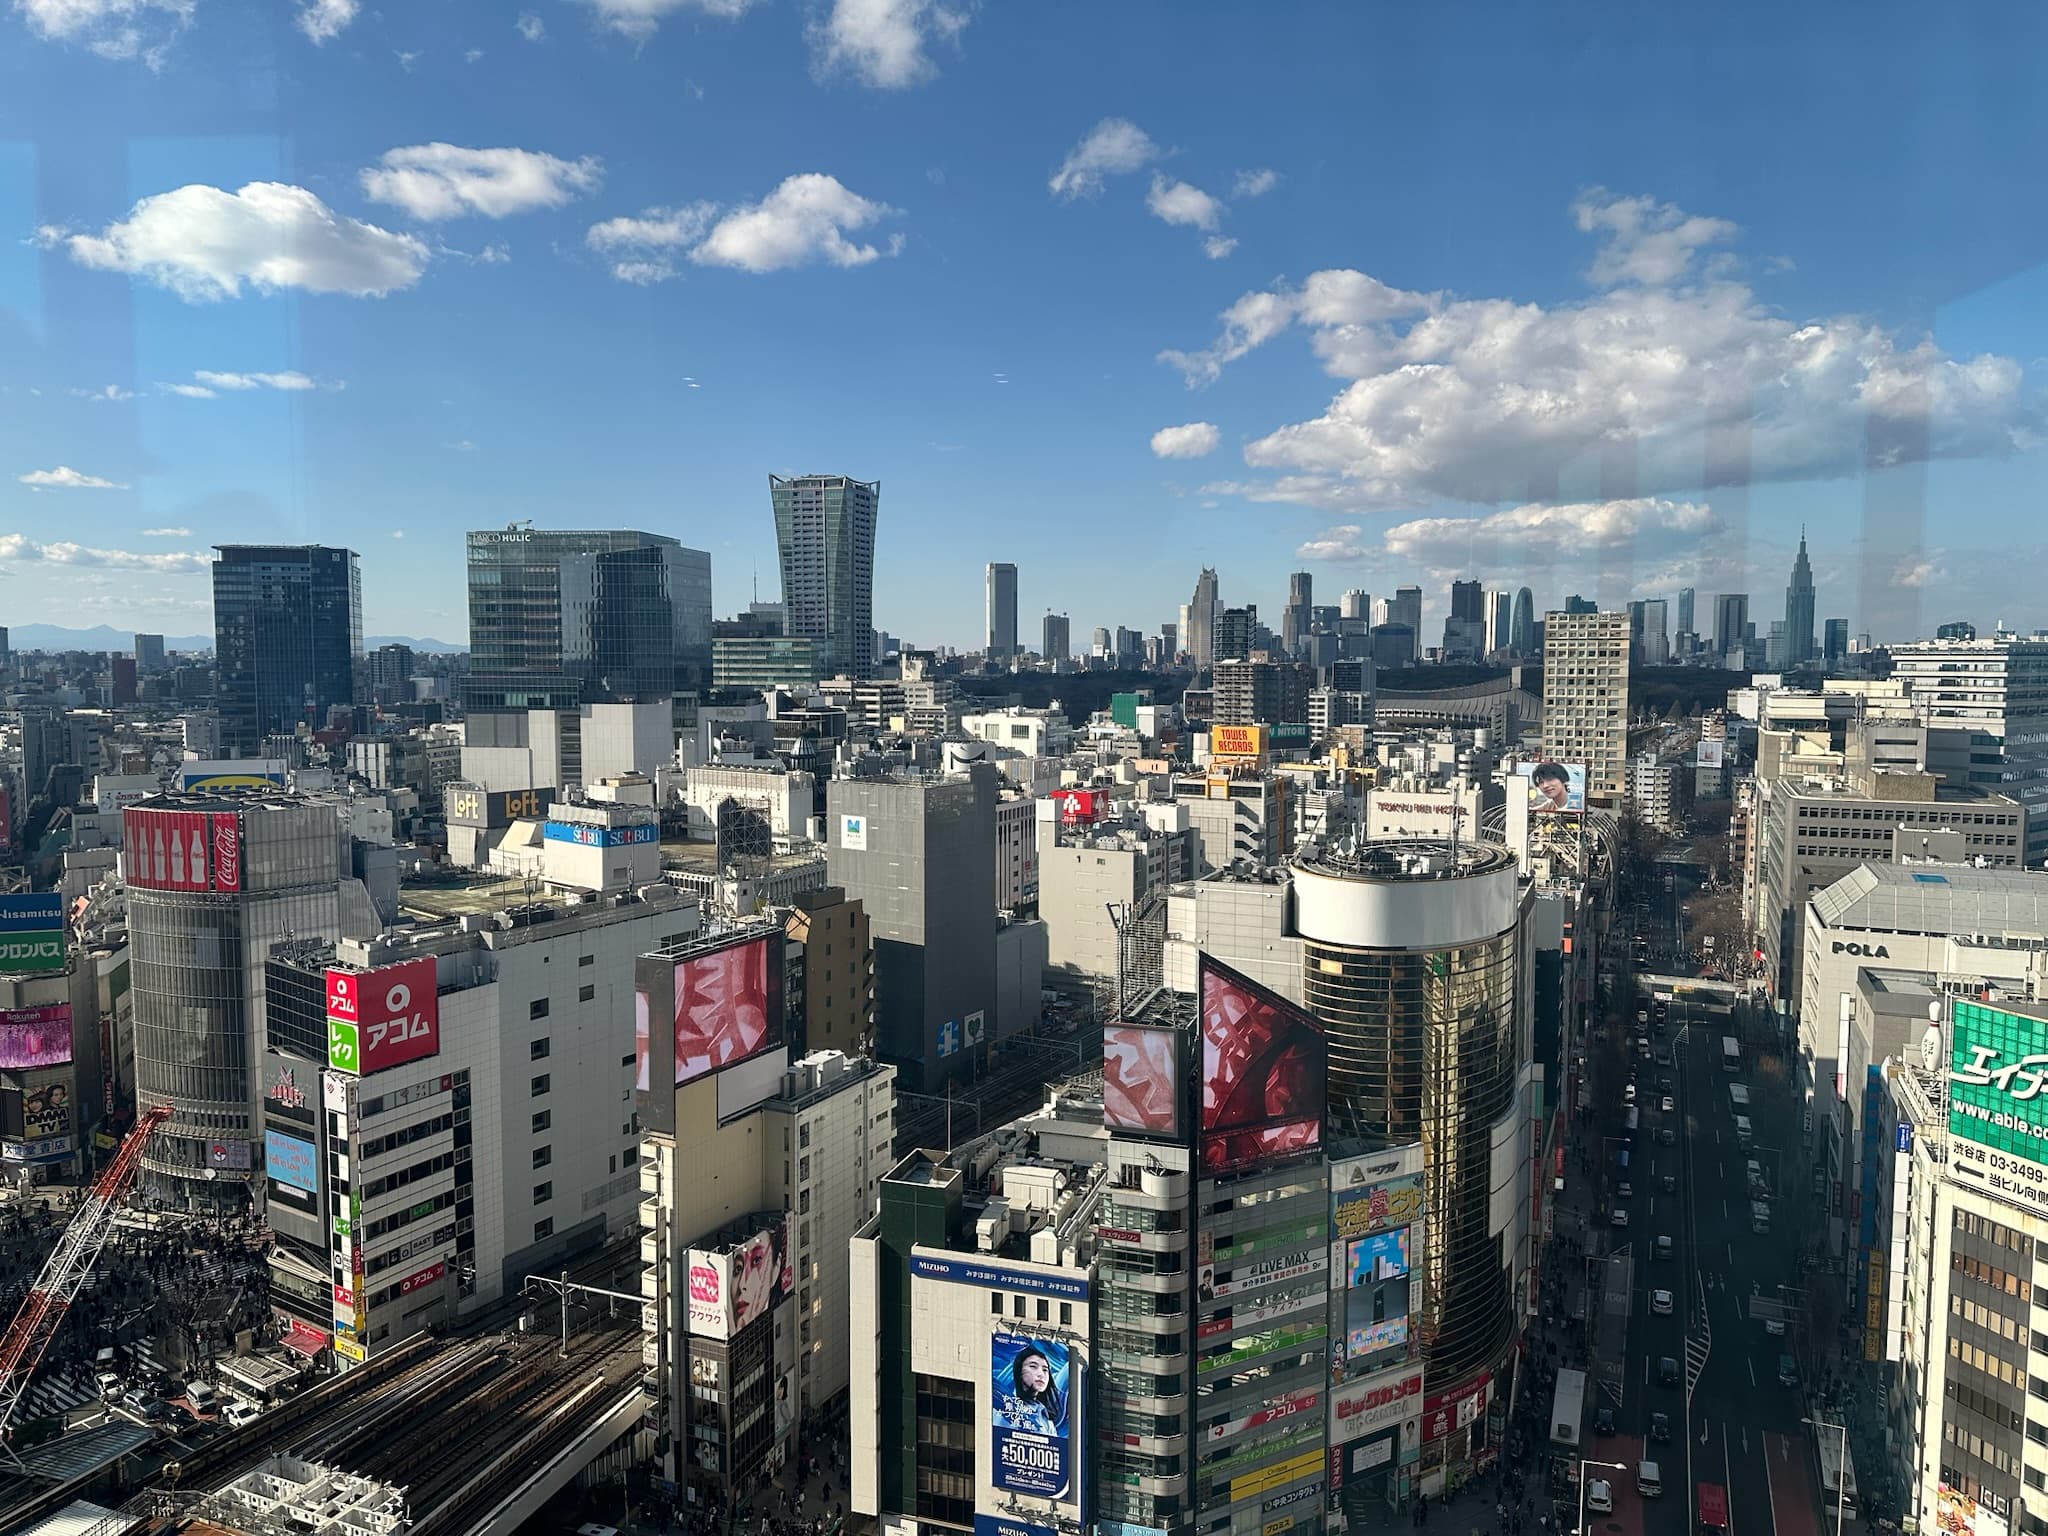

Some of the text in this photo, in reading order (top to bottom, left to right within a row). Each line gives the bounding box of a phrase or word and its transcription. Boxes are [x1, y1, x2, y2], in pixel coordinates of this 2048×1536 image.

[502, 534, 531, 543] HULIC
[1221, 728, 1248, 741] TOWER
[1218, 740, 1254, 753] RECORDS
[1376, 801, 1413, 813] TOKYU
[572, 830, 600, 846] SEIBU
[609, 829, 651, 845] SEIBU
[1832, 941, 1890, 959] POLA
[330, 995, 355, 1014] アコム
[366, 1012, 431, 1052] アコム
[1949, 1044, 2048, 1100] エイブ
[26, 1108, 68, 1126] DMM
[38, 1121, 57, 1134] TV
[1953, 1141, 1986, 1164] 渋谷店
[1285, 1251, 1309, 1266] MAX
[918, 1261, 950, 1273] MIZUHO
[413, 1271, 434, 1286] アコム
[965, 1270, 997, 1281] みずほ銀行
[337, 1289, 354, 1304] アコ
[689, 1310, 721, 1324] ワクワク
[1265, 1401, 1297, 1422] アコム
[1009, 1444, 1053, 1469] 50,000
[1272, 1487, 1315, 1509] 中央コンタクト
[1266, 1519, 1291, 1533] プロミス
